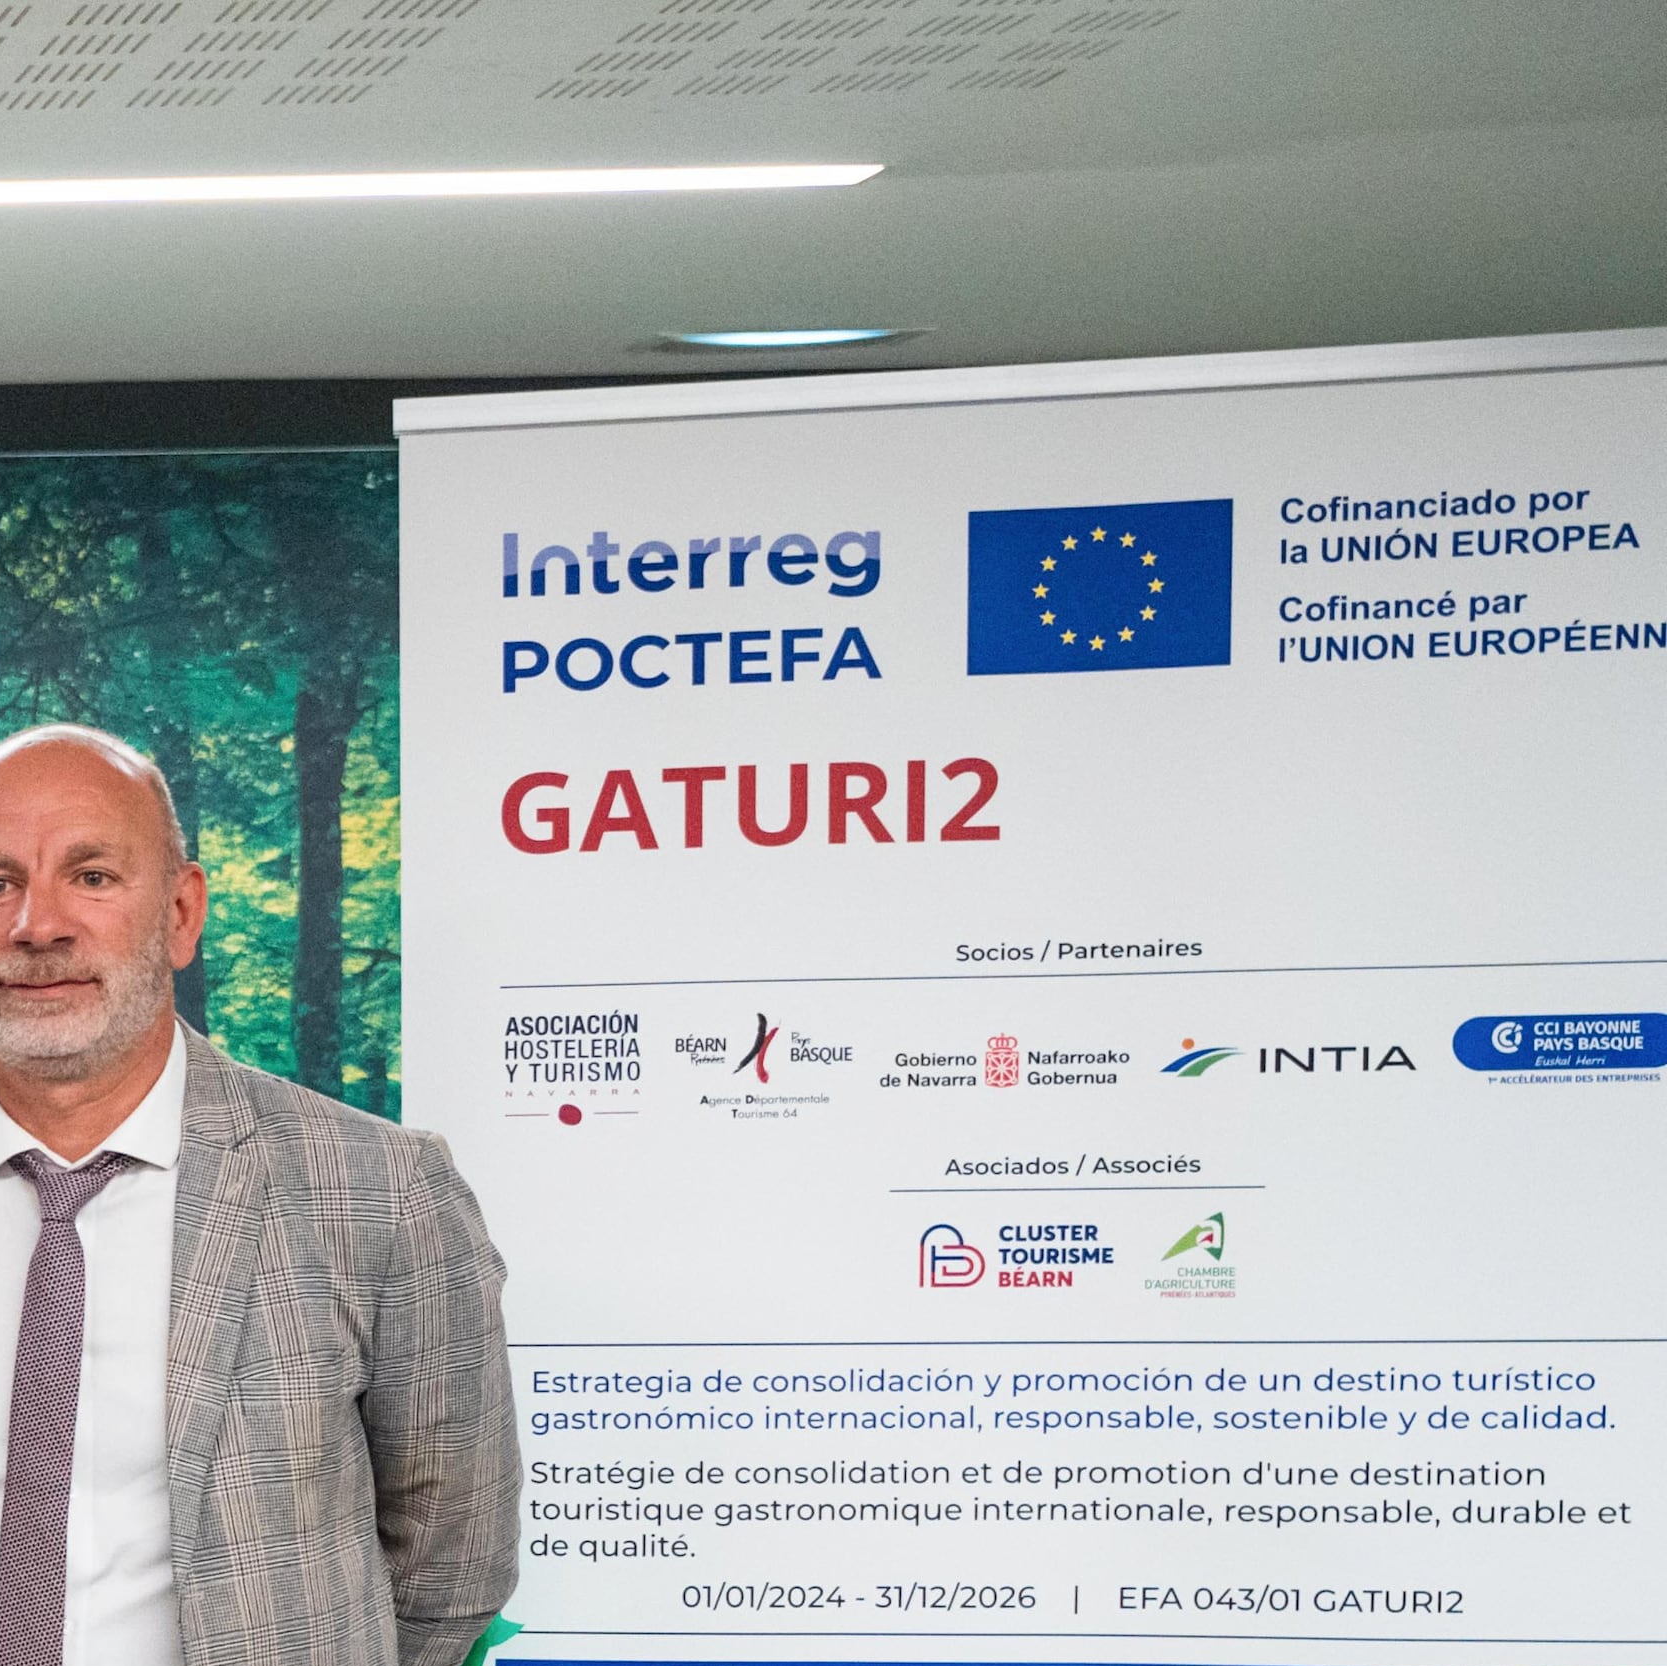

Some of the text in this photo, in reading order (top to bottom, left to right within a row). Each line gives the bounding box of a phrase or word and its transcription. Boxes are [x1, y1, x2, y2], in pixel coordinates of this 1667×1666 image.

[1280, 488, 1591, 525] Cofinanciado por
[1280, 522, 1640, 565] la UNIÓN EUROPEA
[502, 530, 881, 598] Interreg
[1279, 590, 1528, 623] Cofinancé par
[1279, 619, 1667, 663] l’UNION EUROPÉENN
[502, 626, 883, 693] POCTEFA
[500, 757, 1001, 855] GATURI2
[505, 1009, 639, 1038] ASOCIACIÓN
[504, 1037, 641, 1061] HOSTELERÍA
[1259, 1045, 1417, 1074] INTIA
[505, 1060, 641, 1084] Y TURISMO
[530, 1459, 1545, 1491] Stratégie de consolidation et de promotion d'une destination
[529, 1496, 1631, 1529] touristique gastronomique internationale, responsable, durable et
